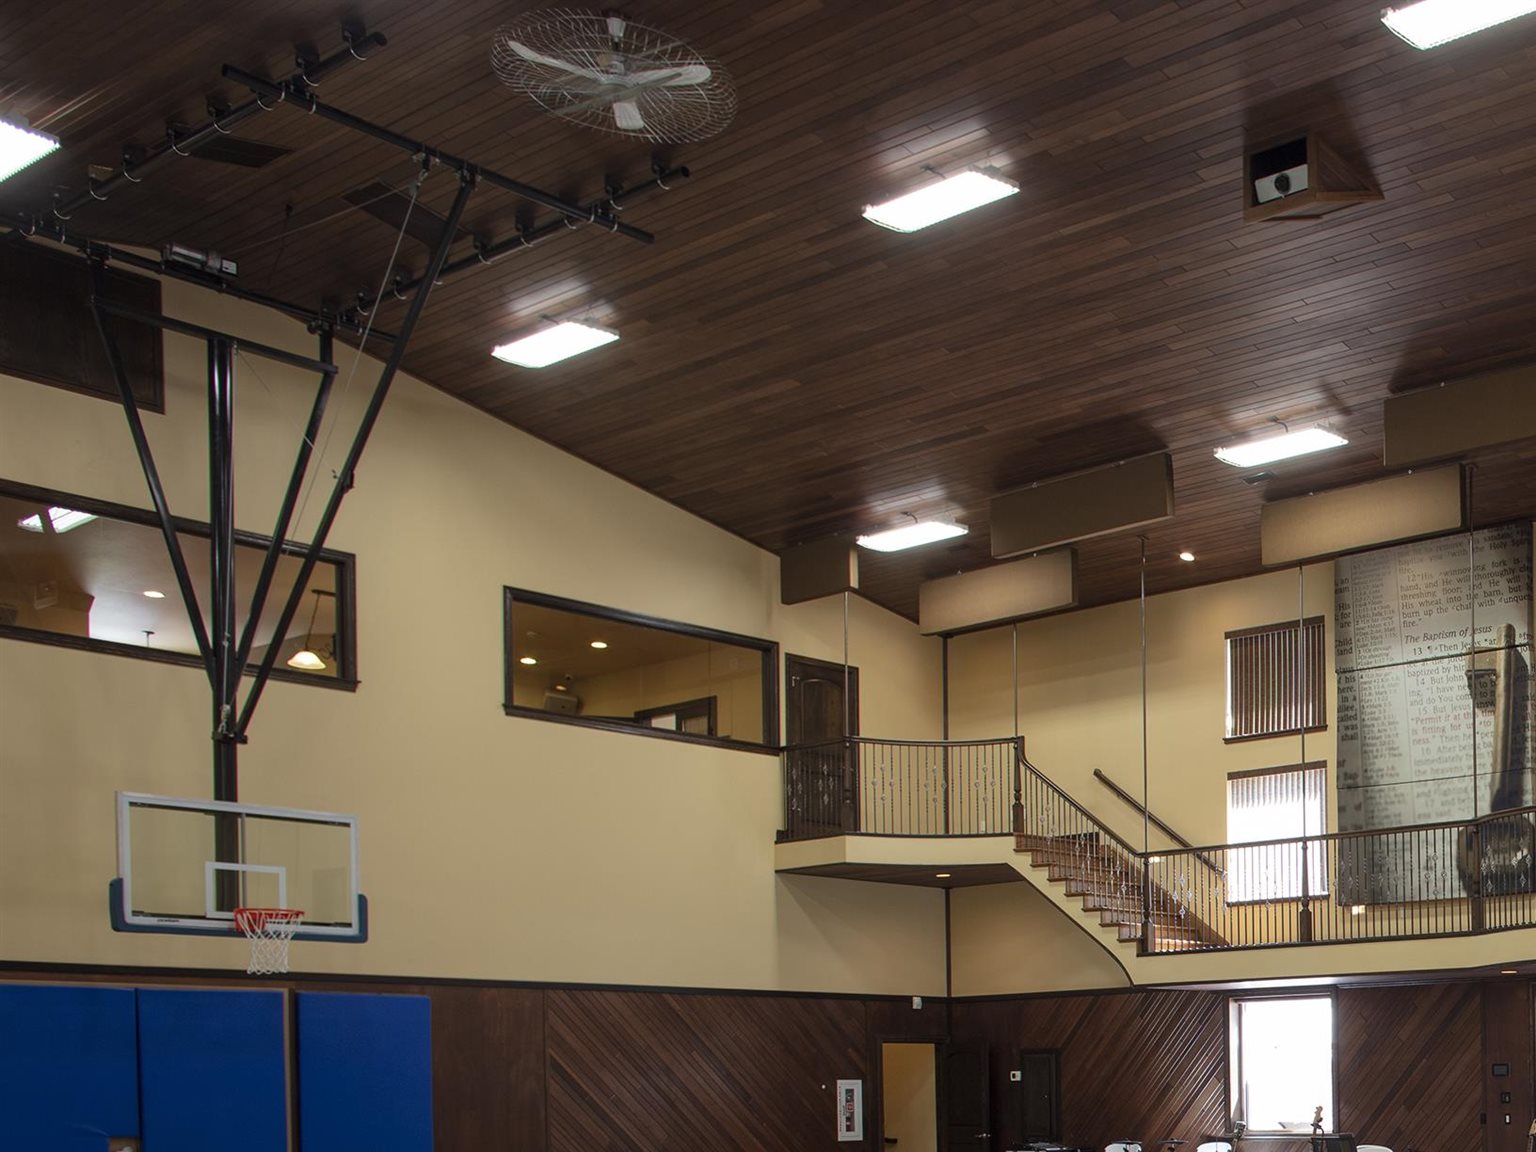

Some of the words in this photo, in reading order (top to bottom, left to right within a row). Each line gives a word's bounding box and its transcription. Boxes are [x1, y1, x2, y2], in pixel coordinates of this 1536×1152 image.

[1405, 633, 1420, 644] The
[1422, 629, 1457, 642] Baptism
[1459, 626, 1470, 638] of
[1413, 646, 1423, 656] 13
